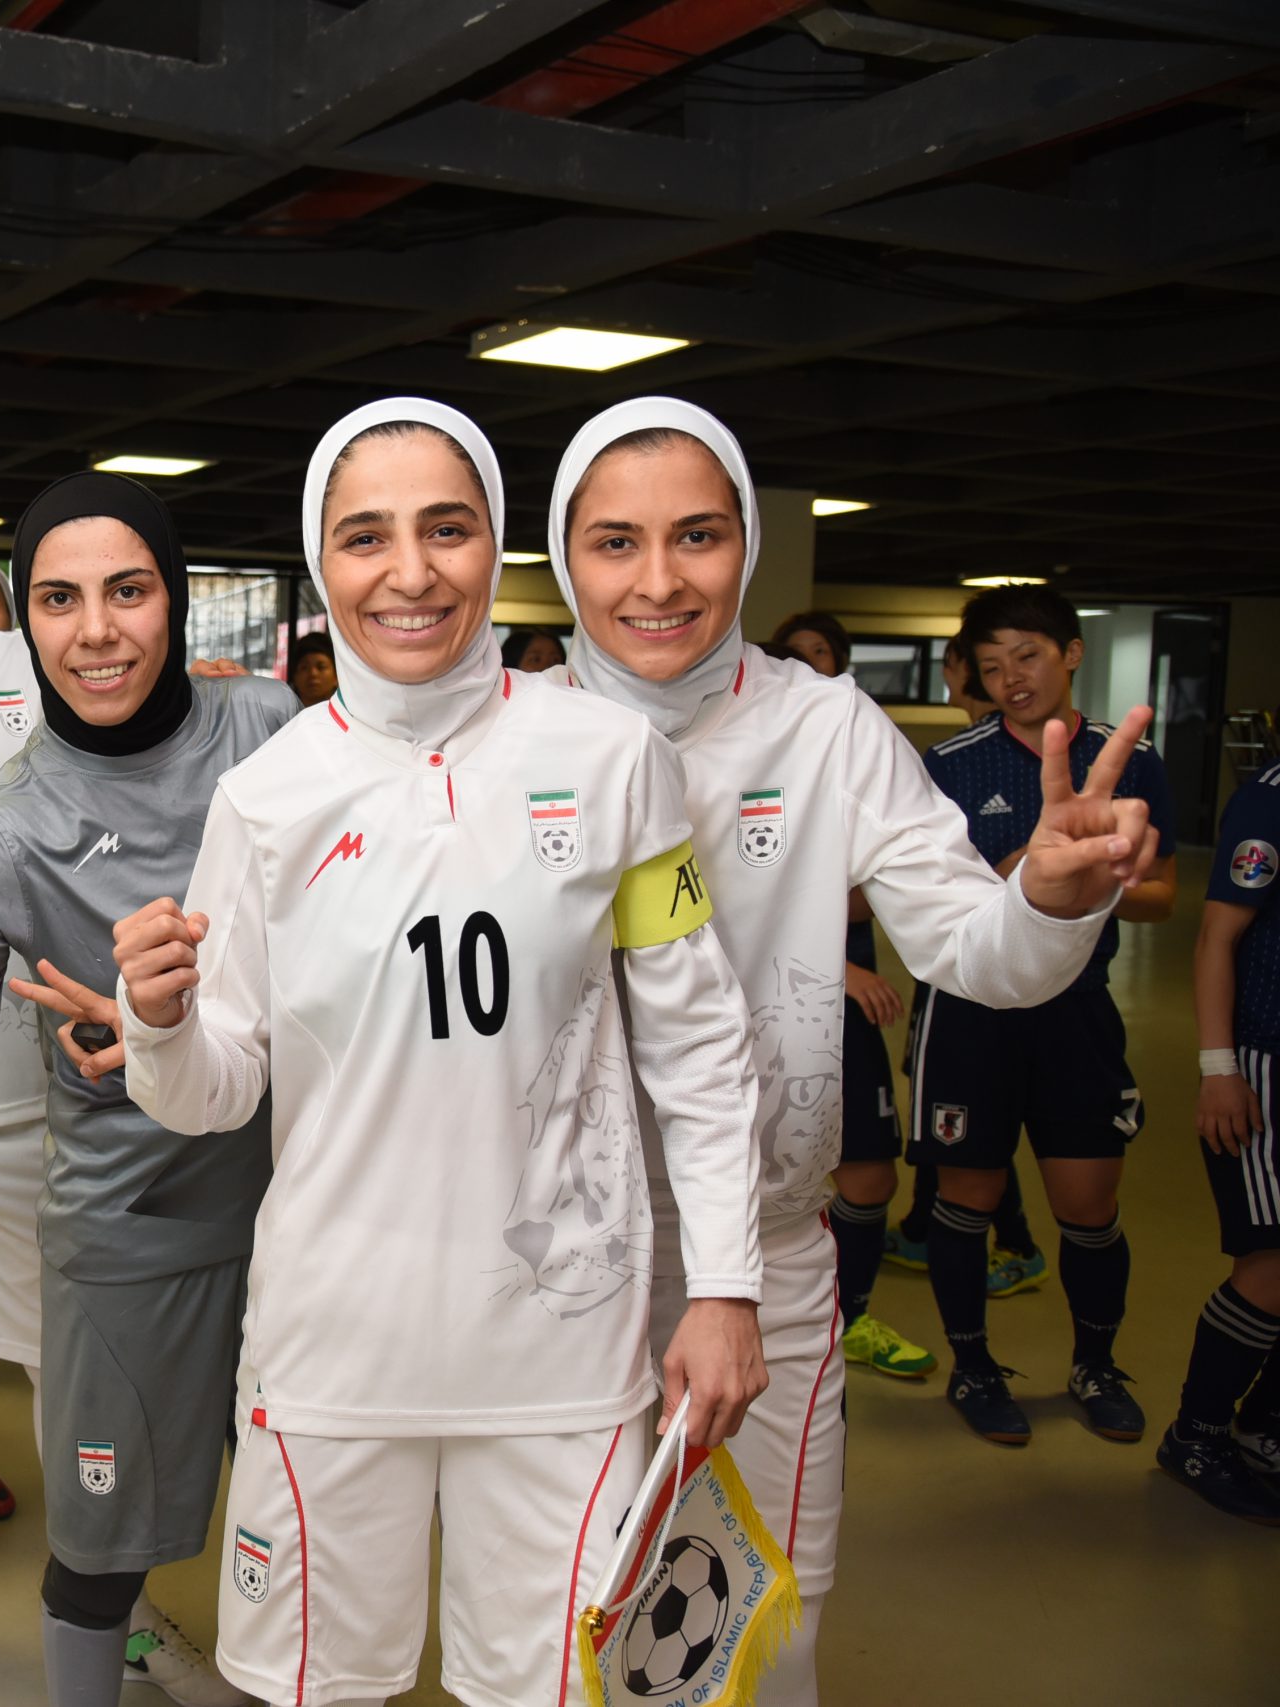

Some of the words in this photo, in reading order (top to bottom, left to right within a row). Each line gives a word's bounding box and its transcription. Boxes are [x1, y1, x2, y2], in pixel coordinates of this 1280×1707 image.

[406, 910, 510, 1040] 10
[705, 1476, 727, 1510] IRAN
[721, 1512, 737, 1531] OF
[638, 1563, 670, 1610] IRAN
[733, 1532, 767, 1608] REPUBLIC
[710, 1612, 748, 1684] ISLAMIC
[691, 1682, 710, 1704] OF
